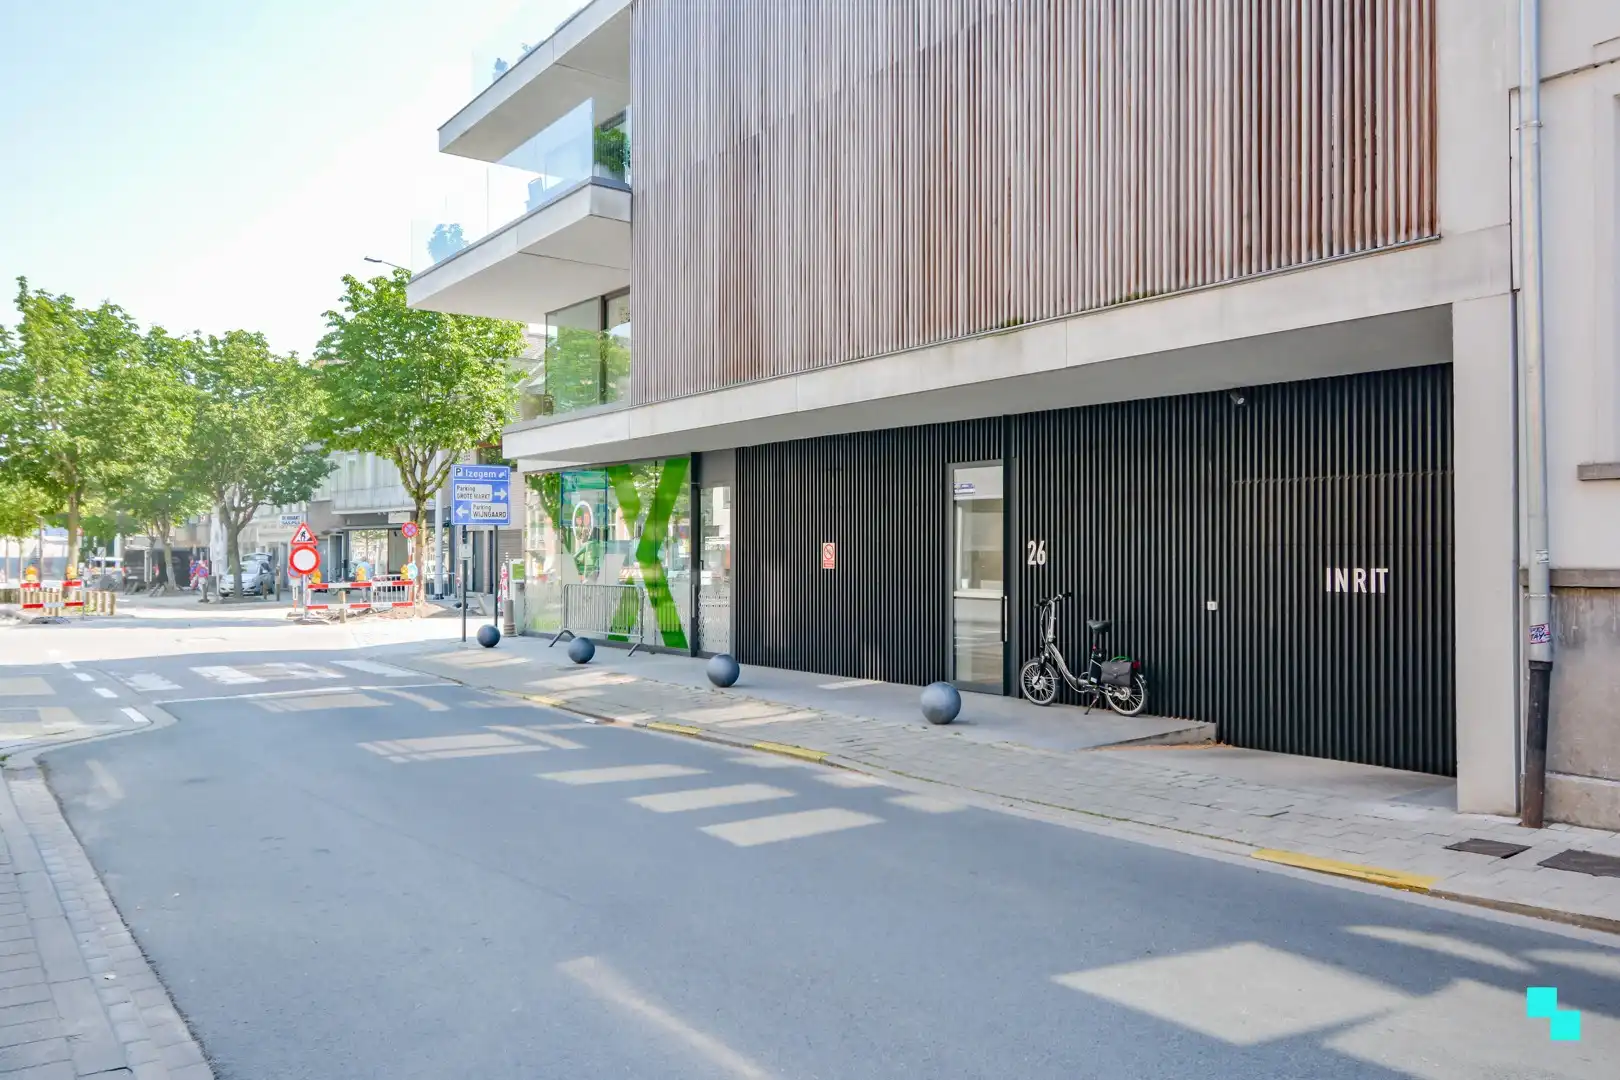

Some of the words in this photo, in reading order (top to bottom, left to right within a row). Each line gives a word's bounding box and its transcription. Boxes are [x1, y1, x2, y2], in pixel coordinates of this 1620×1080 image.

[466, 469, 496, 479] Izegem
[1027, 540, 1046, 566] 26
[1326, 567, 1388, 593] INRIT
